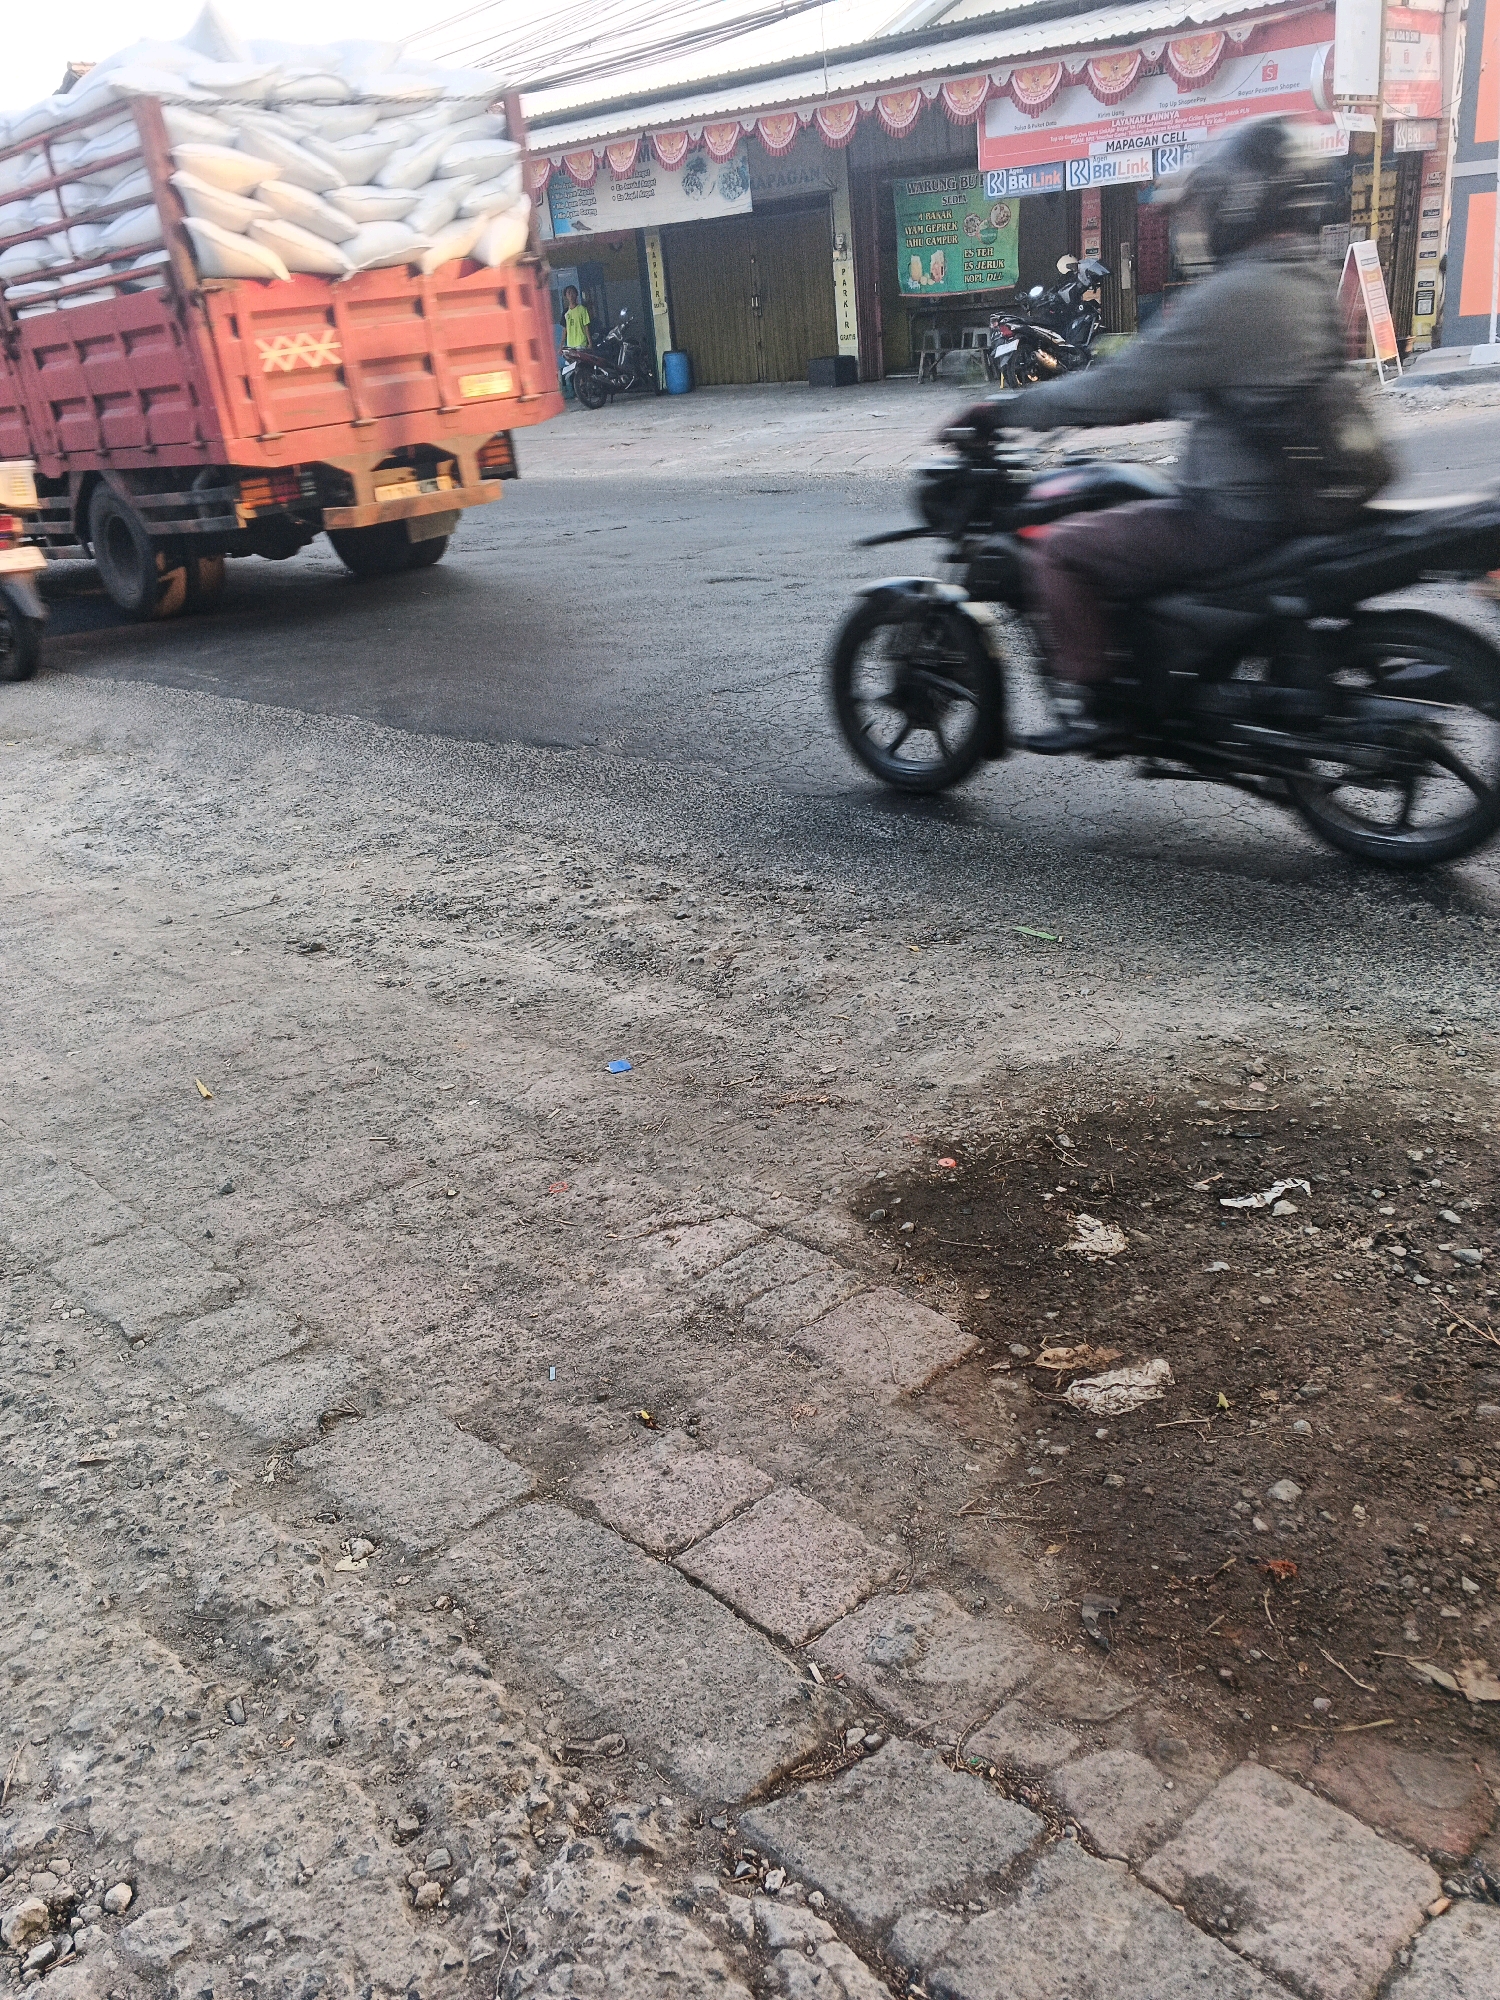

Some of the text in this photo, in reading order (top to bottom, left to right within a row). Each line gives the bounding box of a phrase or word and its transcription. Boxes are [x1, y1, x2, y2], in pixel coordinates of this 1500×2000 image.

[1237, 81, 1300, 97] Bayar Pesanan Shopee
[1169, 100, 1177, 108] Up
[1178, 97, 1207, 106] ShopeePay
[1111, 110, 1180, 128] LAYANAN LAINNYA
[1105, 131, 1187, 153] MAPAGAN CELL
[1183, 143, 1200, 151] Agen
[1092, 155, 1108, 164] Agen
[1009, 168, 1024, 176] Agen
[1093, 157, 1150, 180] BRILink
[906, 176, 957, 195] WARUNG
[959, 174, 978, 190] BU
[1008, 169, 1062, 190] BRILink
[925, 221, 958, 233] GEPREK
[925, 235, 958, 247] CAMPUR
[964, 247, 994, 258] ES TEH
[964, 259, 1005, 271] ES JERUK
[841, 268, 850, 329] PARKIR
